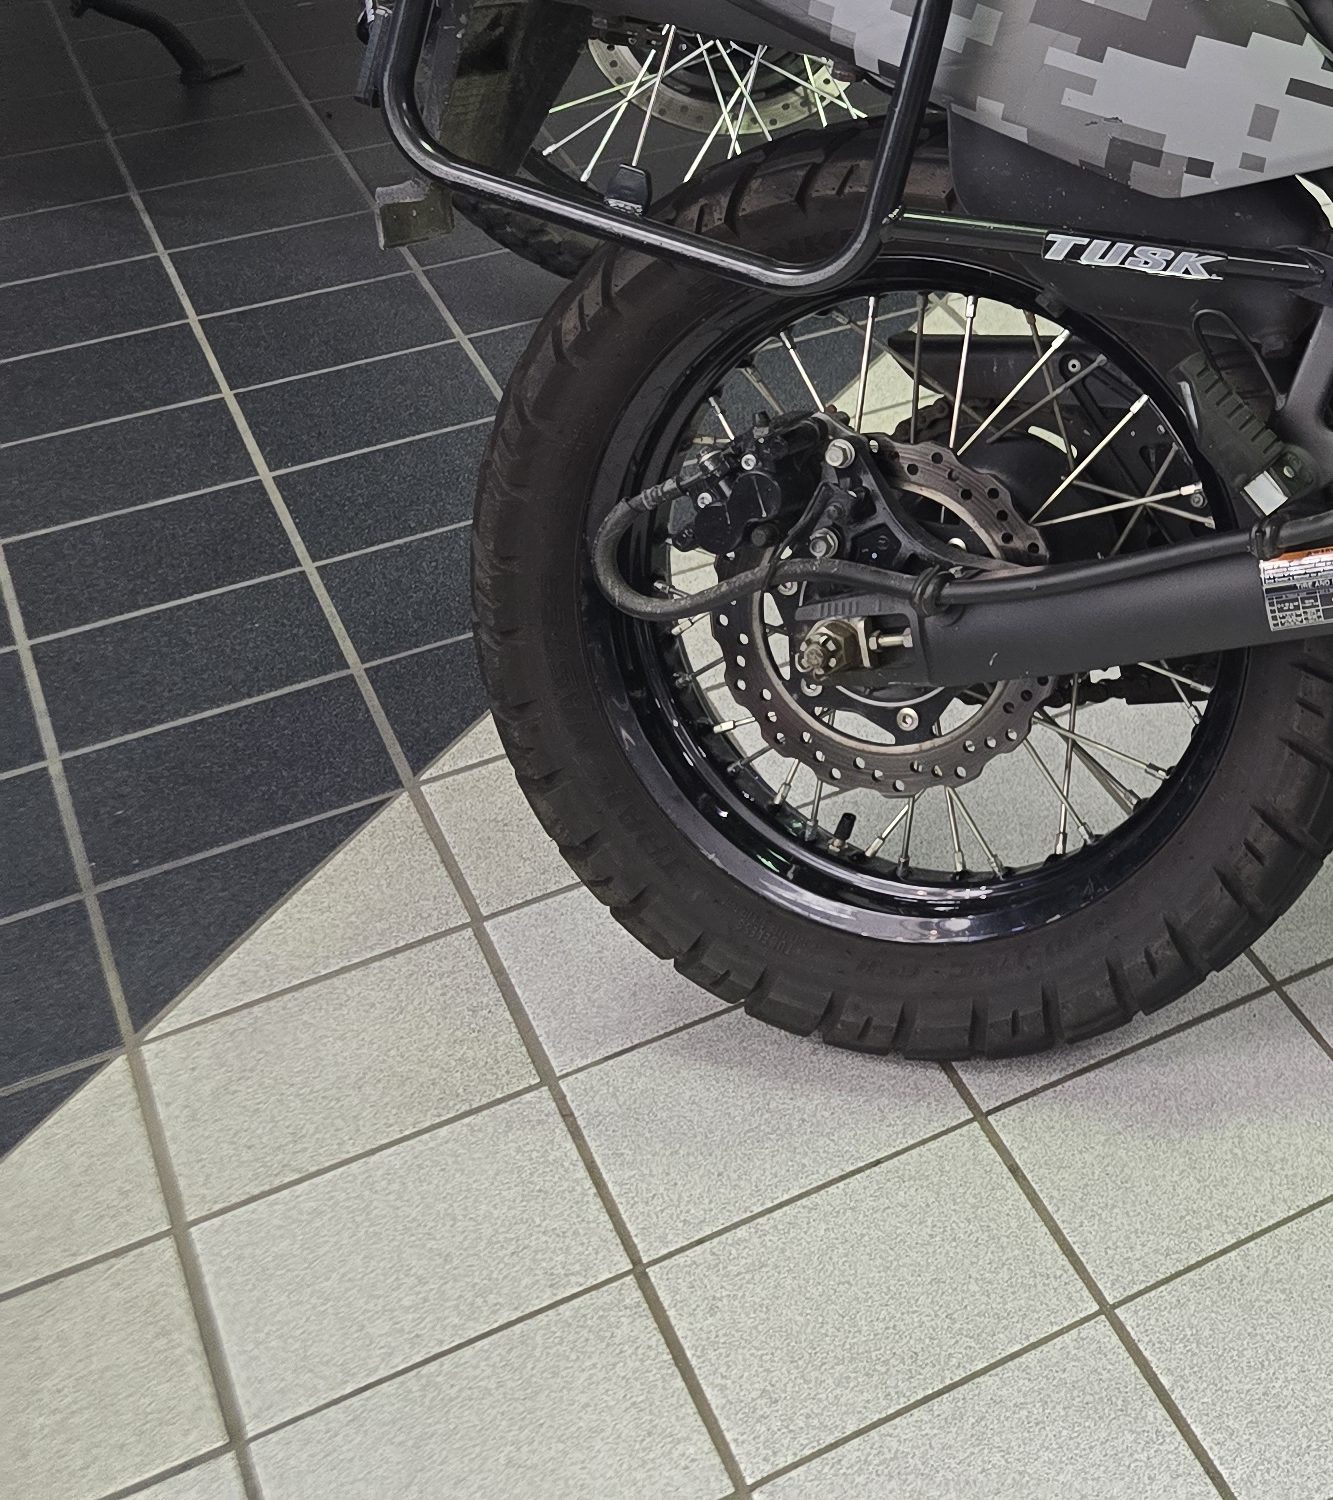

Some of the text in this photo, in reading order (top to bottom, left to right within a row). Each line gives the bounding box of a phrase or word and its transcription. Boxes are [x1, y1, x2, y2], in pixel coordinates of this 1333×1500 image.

[1044, 233, 1227, 279] TUSK
[1295, 581, 1313, 590] TIRE
[1314, 578, 1331, 588] AND
